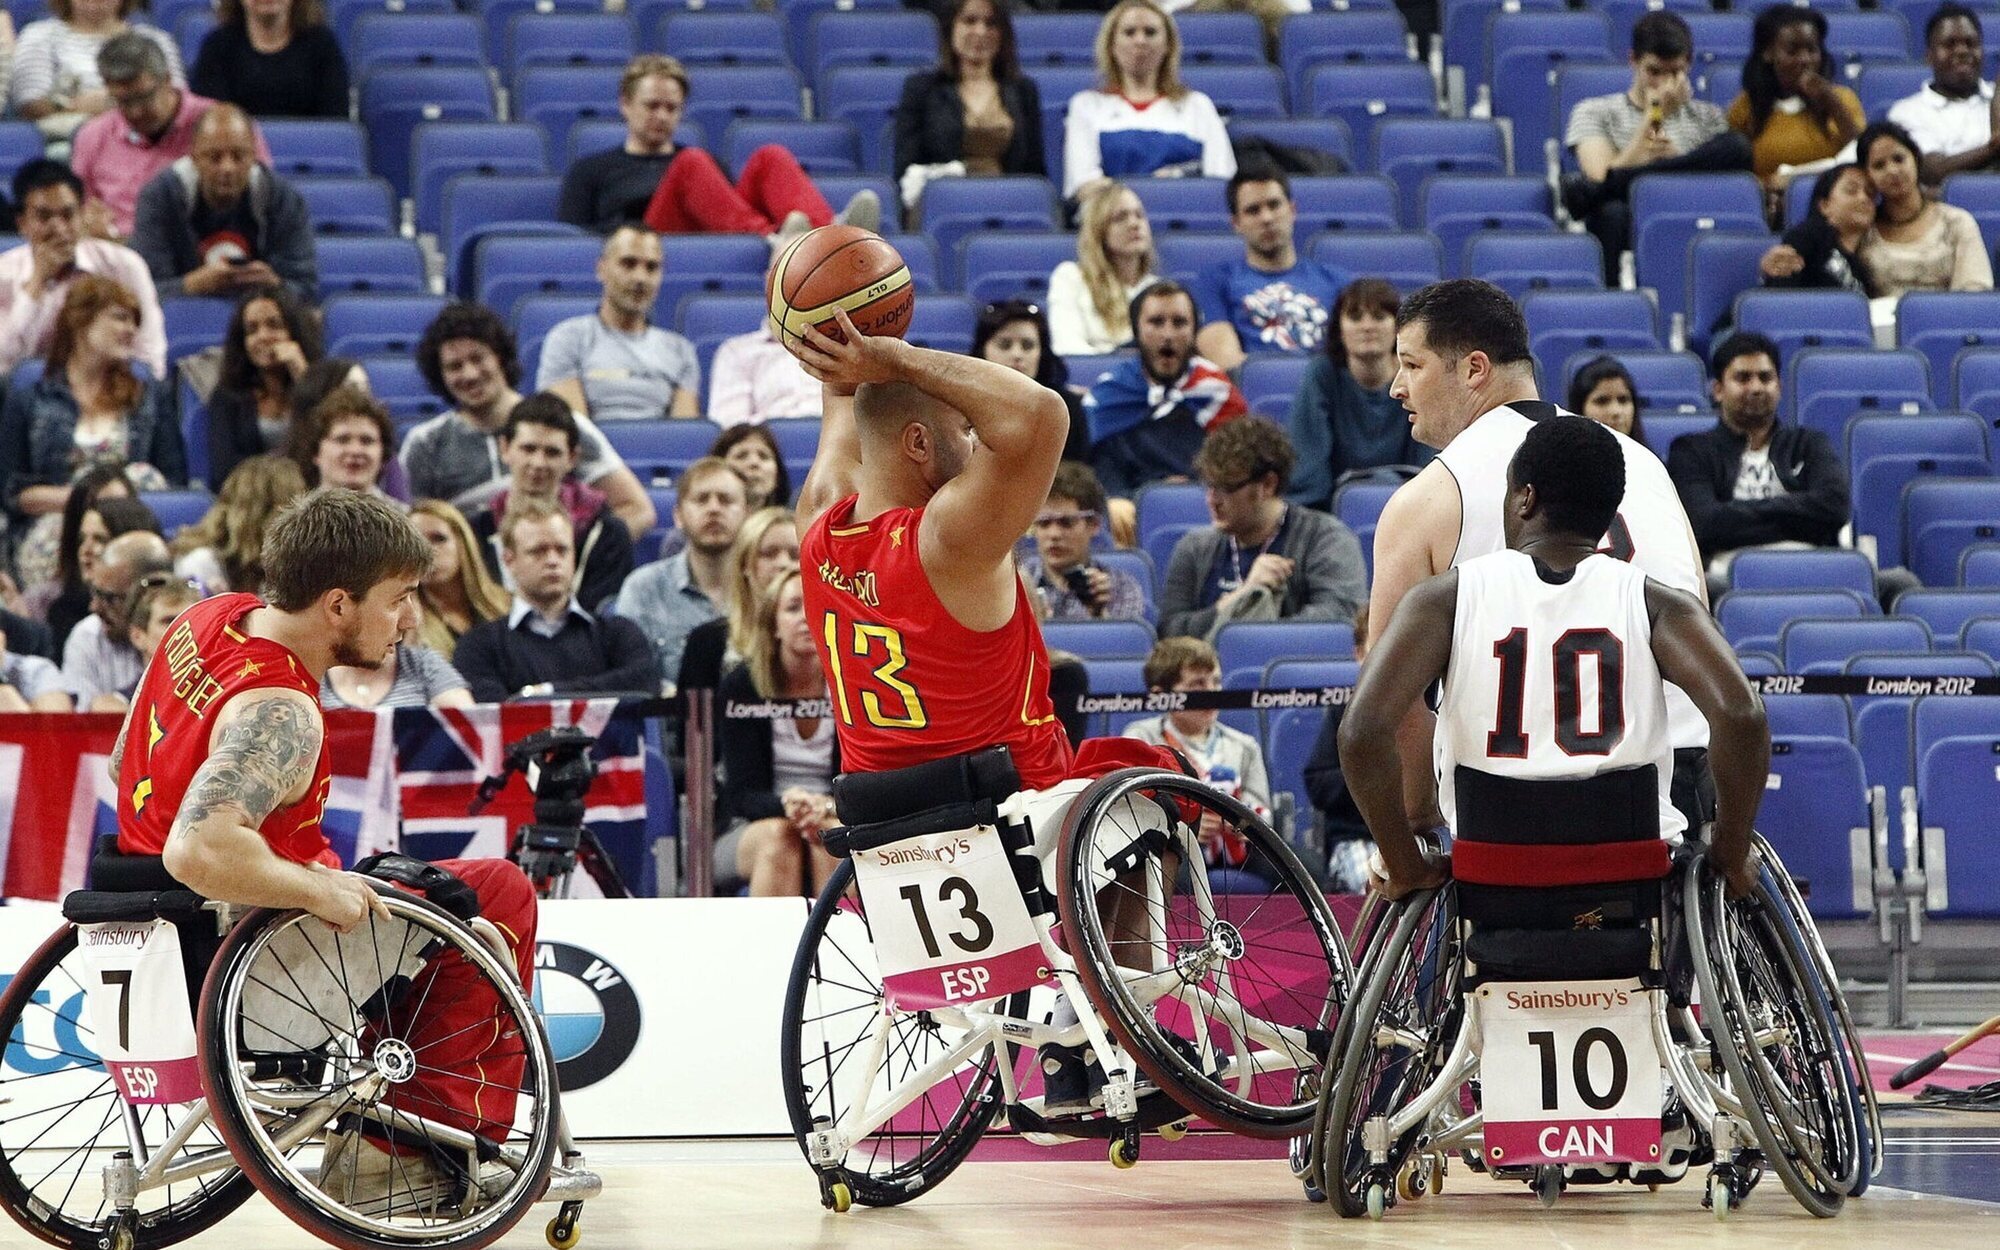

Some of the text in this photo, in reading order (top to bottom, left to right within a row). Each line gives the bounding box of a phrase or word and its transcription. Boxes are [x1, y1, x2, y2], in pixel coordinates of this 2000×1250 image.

[867, 283, 888, 298] GL7
[824, 611, 928, 729] 13
[1764, 676, 1805, 694] 2012
[1252, 688, 1317, 708] London
[1486, 627, 1625, 759] 10
[1867, 676, 1976, 695] London 2012
[725, 699, 793, 719] London
[1076, 692, 1187, 713] London 2012
[878, 838, 971, 866] Sainsbury's
[899, 876, 994, 959] 13
[940, 966, 990, 1001] ESP
[101, 970, 132, 1052] 7
[1507, 988, 1628, 1010] Sainsbury's
[121, 1067, 158, 1099] ESP
[1528, 1027, 1628, 1111] 10
[1538, 1125, 1614, 1157] CAN
